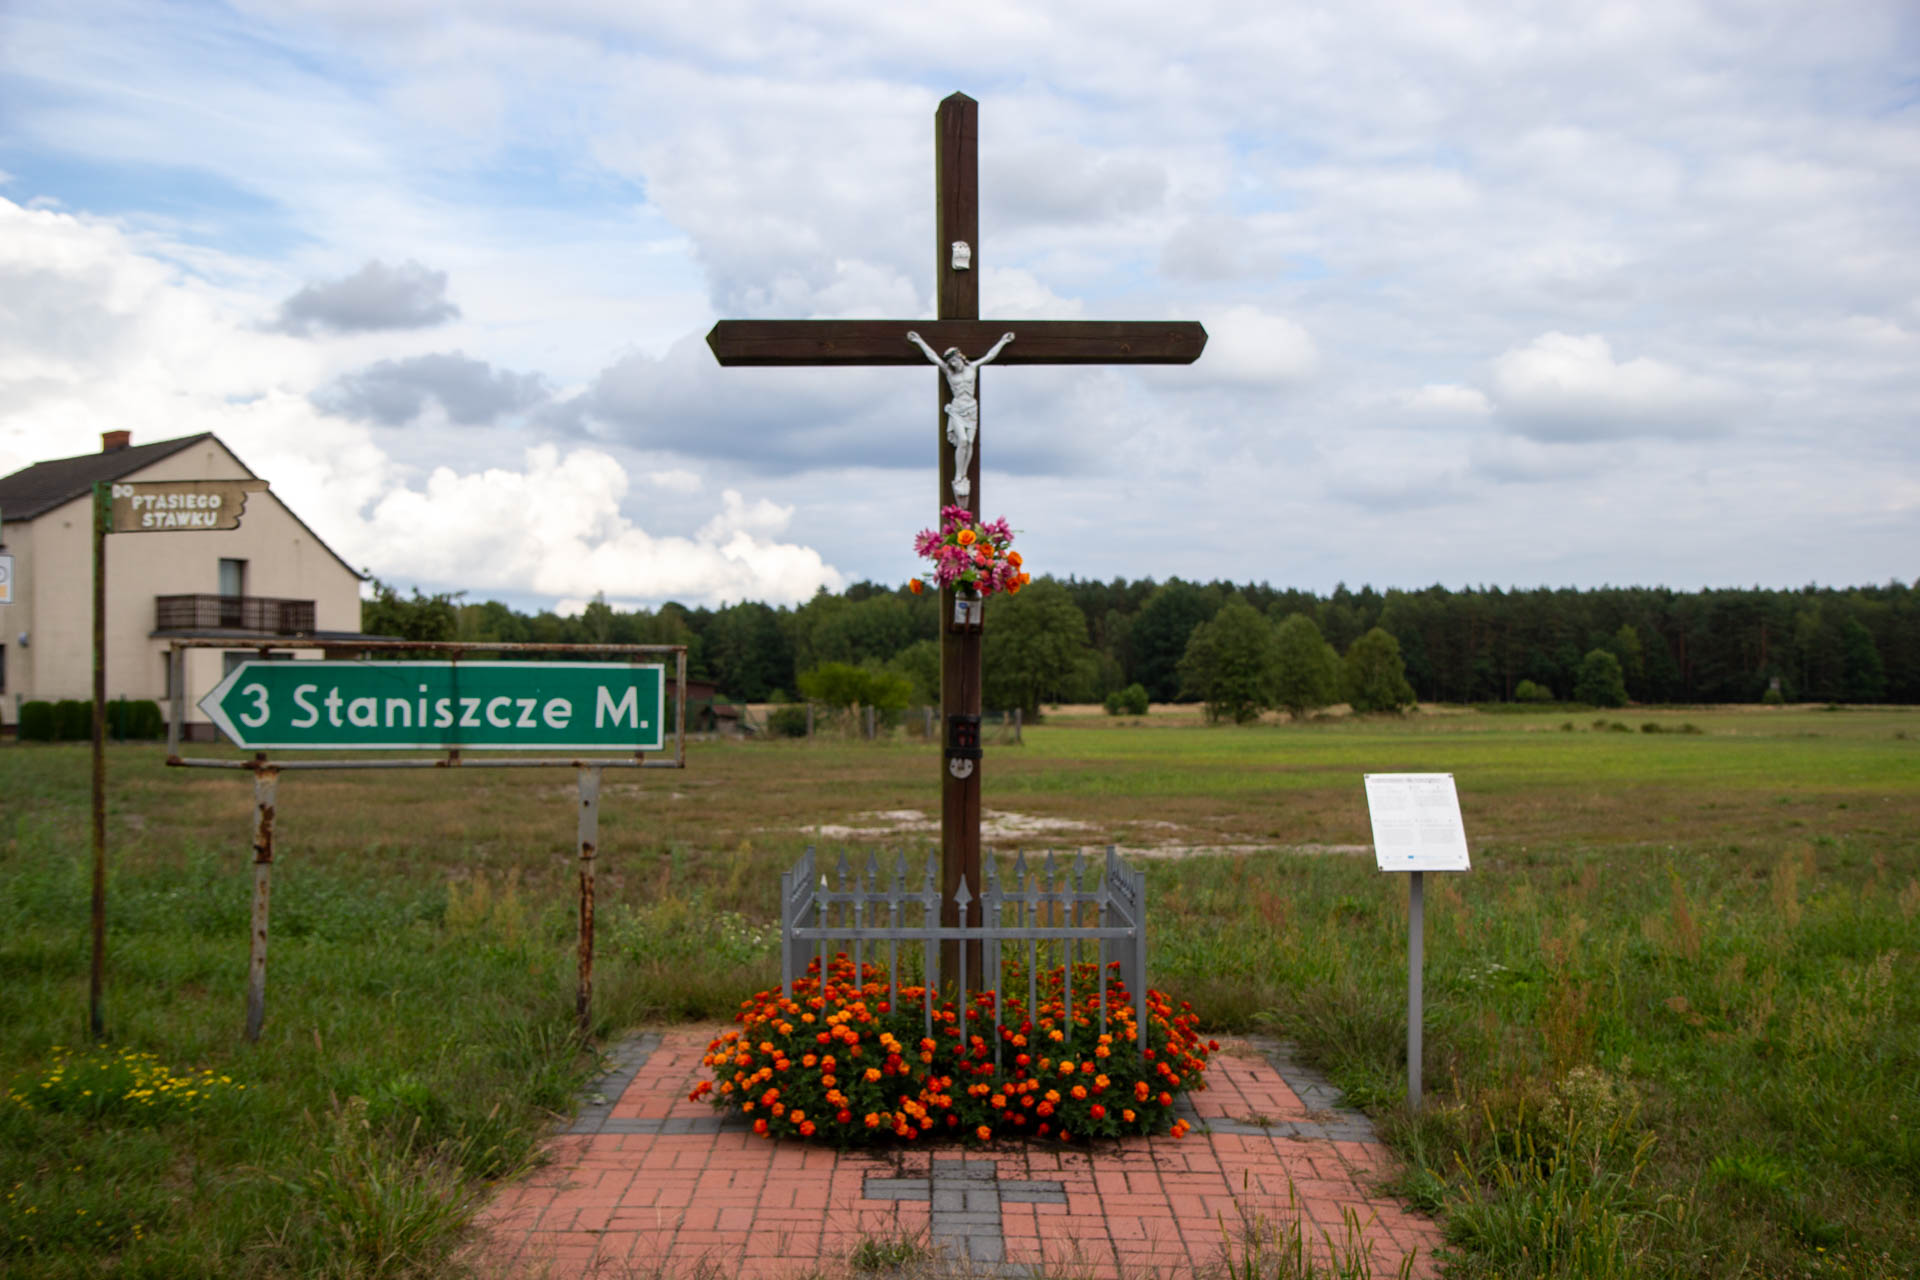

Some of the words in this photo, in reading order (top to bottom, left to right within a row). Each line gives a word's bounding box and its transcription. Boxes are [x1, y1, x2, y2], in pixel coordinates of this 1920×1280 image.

[112, 484, 134, 498] DO
[132, 494, 222, 510] PTASIEGO
[142, 511, 217, 527] STAWKU
[239, 683, 271, 728] 3
[291, 684, 573, 728] Staniszcze
[595, 685, 649, 728] M.
